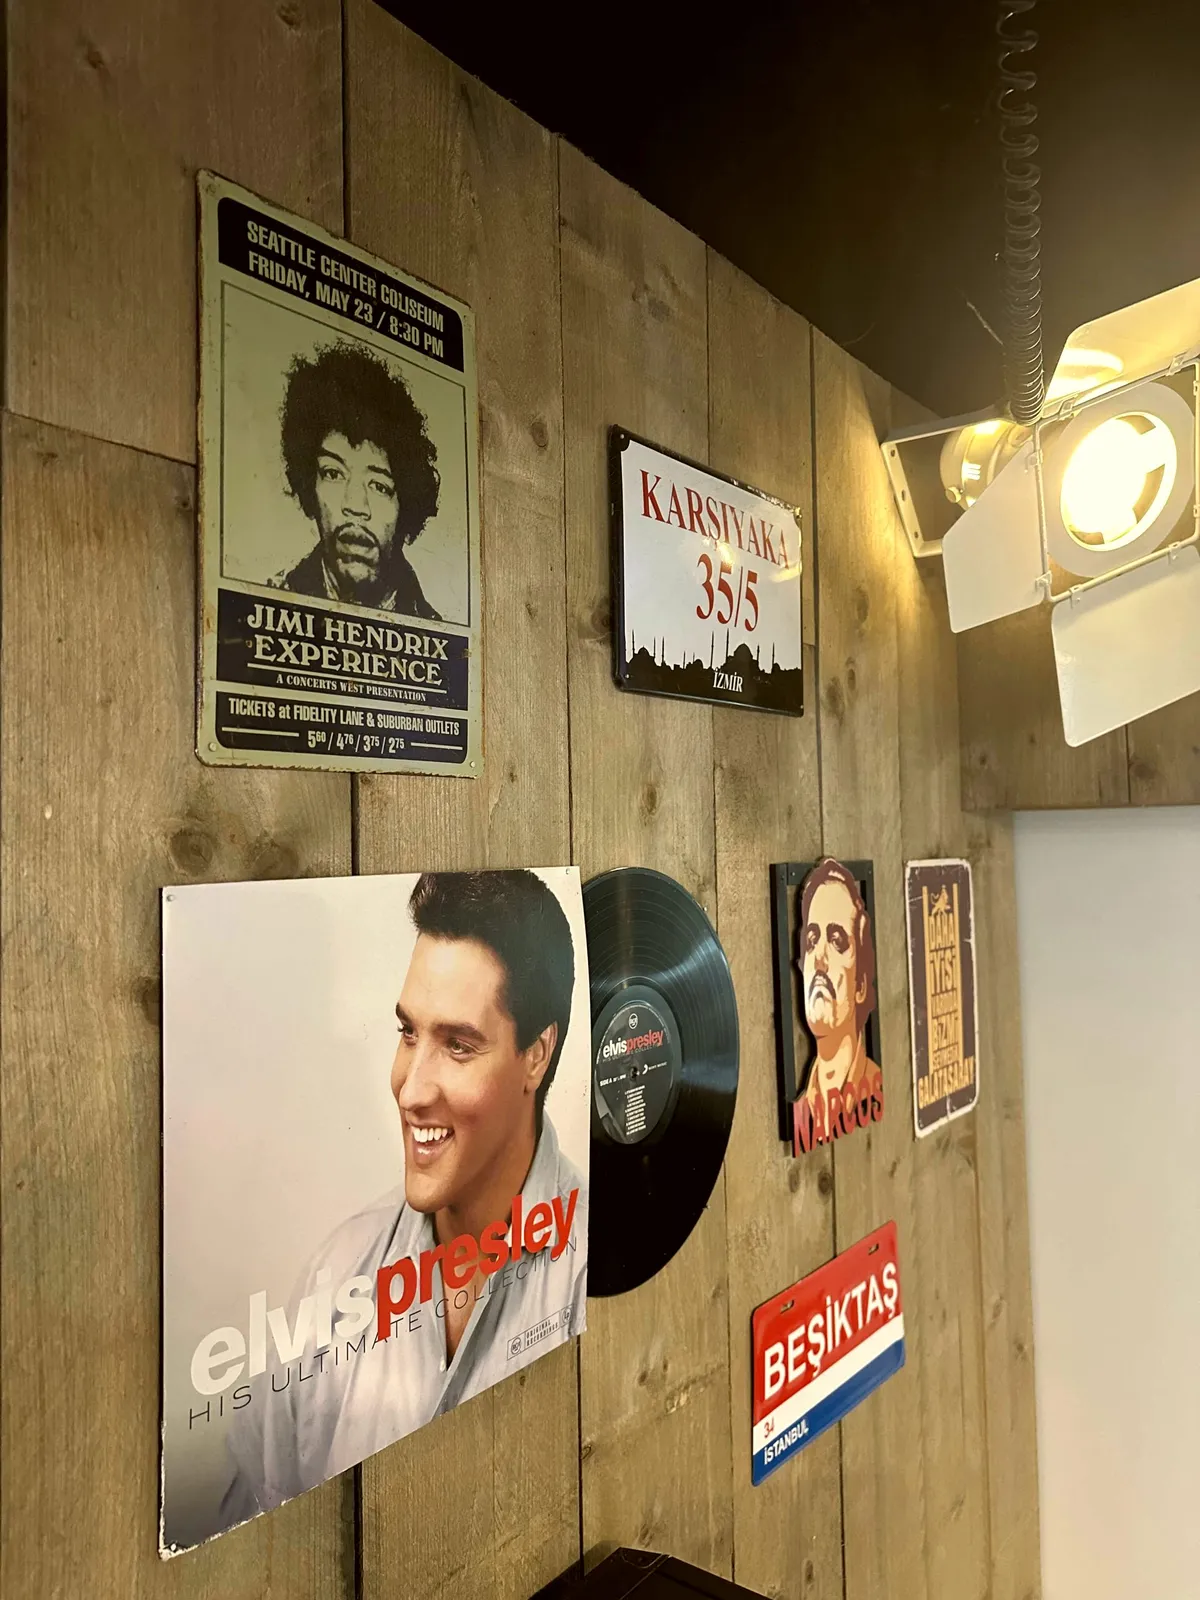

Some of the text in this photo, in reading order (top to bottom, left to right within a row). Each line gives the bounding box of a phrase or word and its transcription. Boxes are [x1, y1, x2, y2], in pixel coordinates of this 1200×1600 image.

[247, 220, 444, 333] SEATTLE CENTER COLISEUM
[248, 250, 310, 299] FRIDAY,
[315, 279, 350, 315] MAY
[354, 299, 373, 324] 23
[389, 315, 420, 347] 8:30
[423, 331, 444, 359] PM
[695, 553, 759, 632] 35/5
[247, 603, 449, 661] JIMI HENDRIX
[253, 634, 443, 686] EXPERIENCE
[712, 667, 744, 693] İZMİR
[276, 673, 427, 702] A CONCERTS WEST PRESENTATION
[228, 697, 460, 736] TICKETS at FIDELITY LANE & SUBURBAN OUTLETS
[793, 1071, 884, 1158] NARCOS
[526, 1319, 551, 1339] ORIGINAL
[526, 1322, 558, 1346] RECORDINGS
[763, 1262, 899, 1401] BEŞİKTAŞ
[189, 1385, 252, 1430] HIS
[763, 1418, 810, 1466] İSTANBUL
